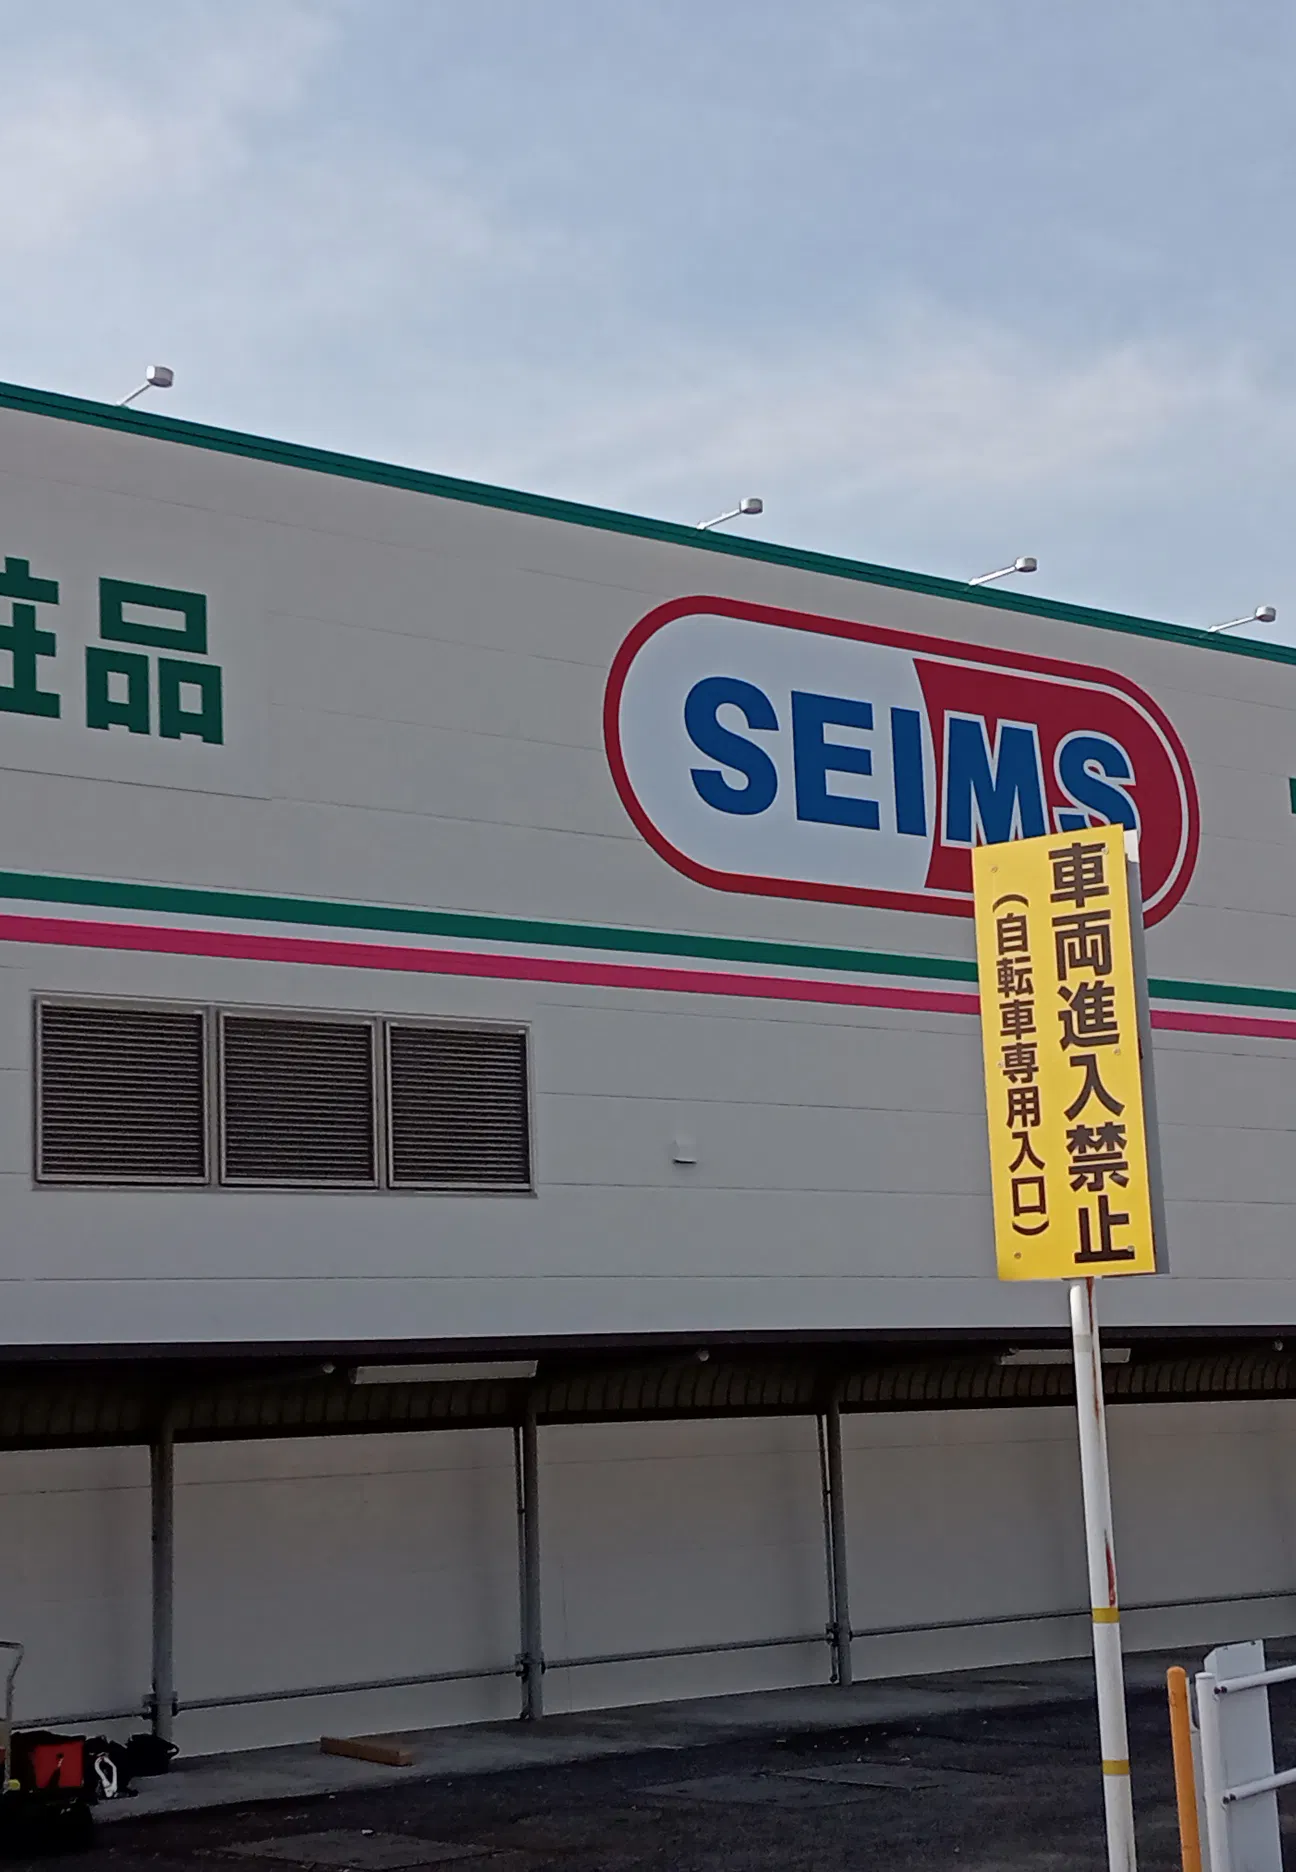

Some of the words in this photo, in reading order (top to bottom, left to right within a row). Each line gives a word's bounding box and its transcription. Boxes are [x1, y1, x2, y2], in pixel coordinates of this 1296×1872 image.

[684, 676, 1141, 848] SEIMS
[992, 893, 1050, 1236] （自転車専用入口）
[1048, 841, 1136, 1264] 車両進入禁止
